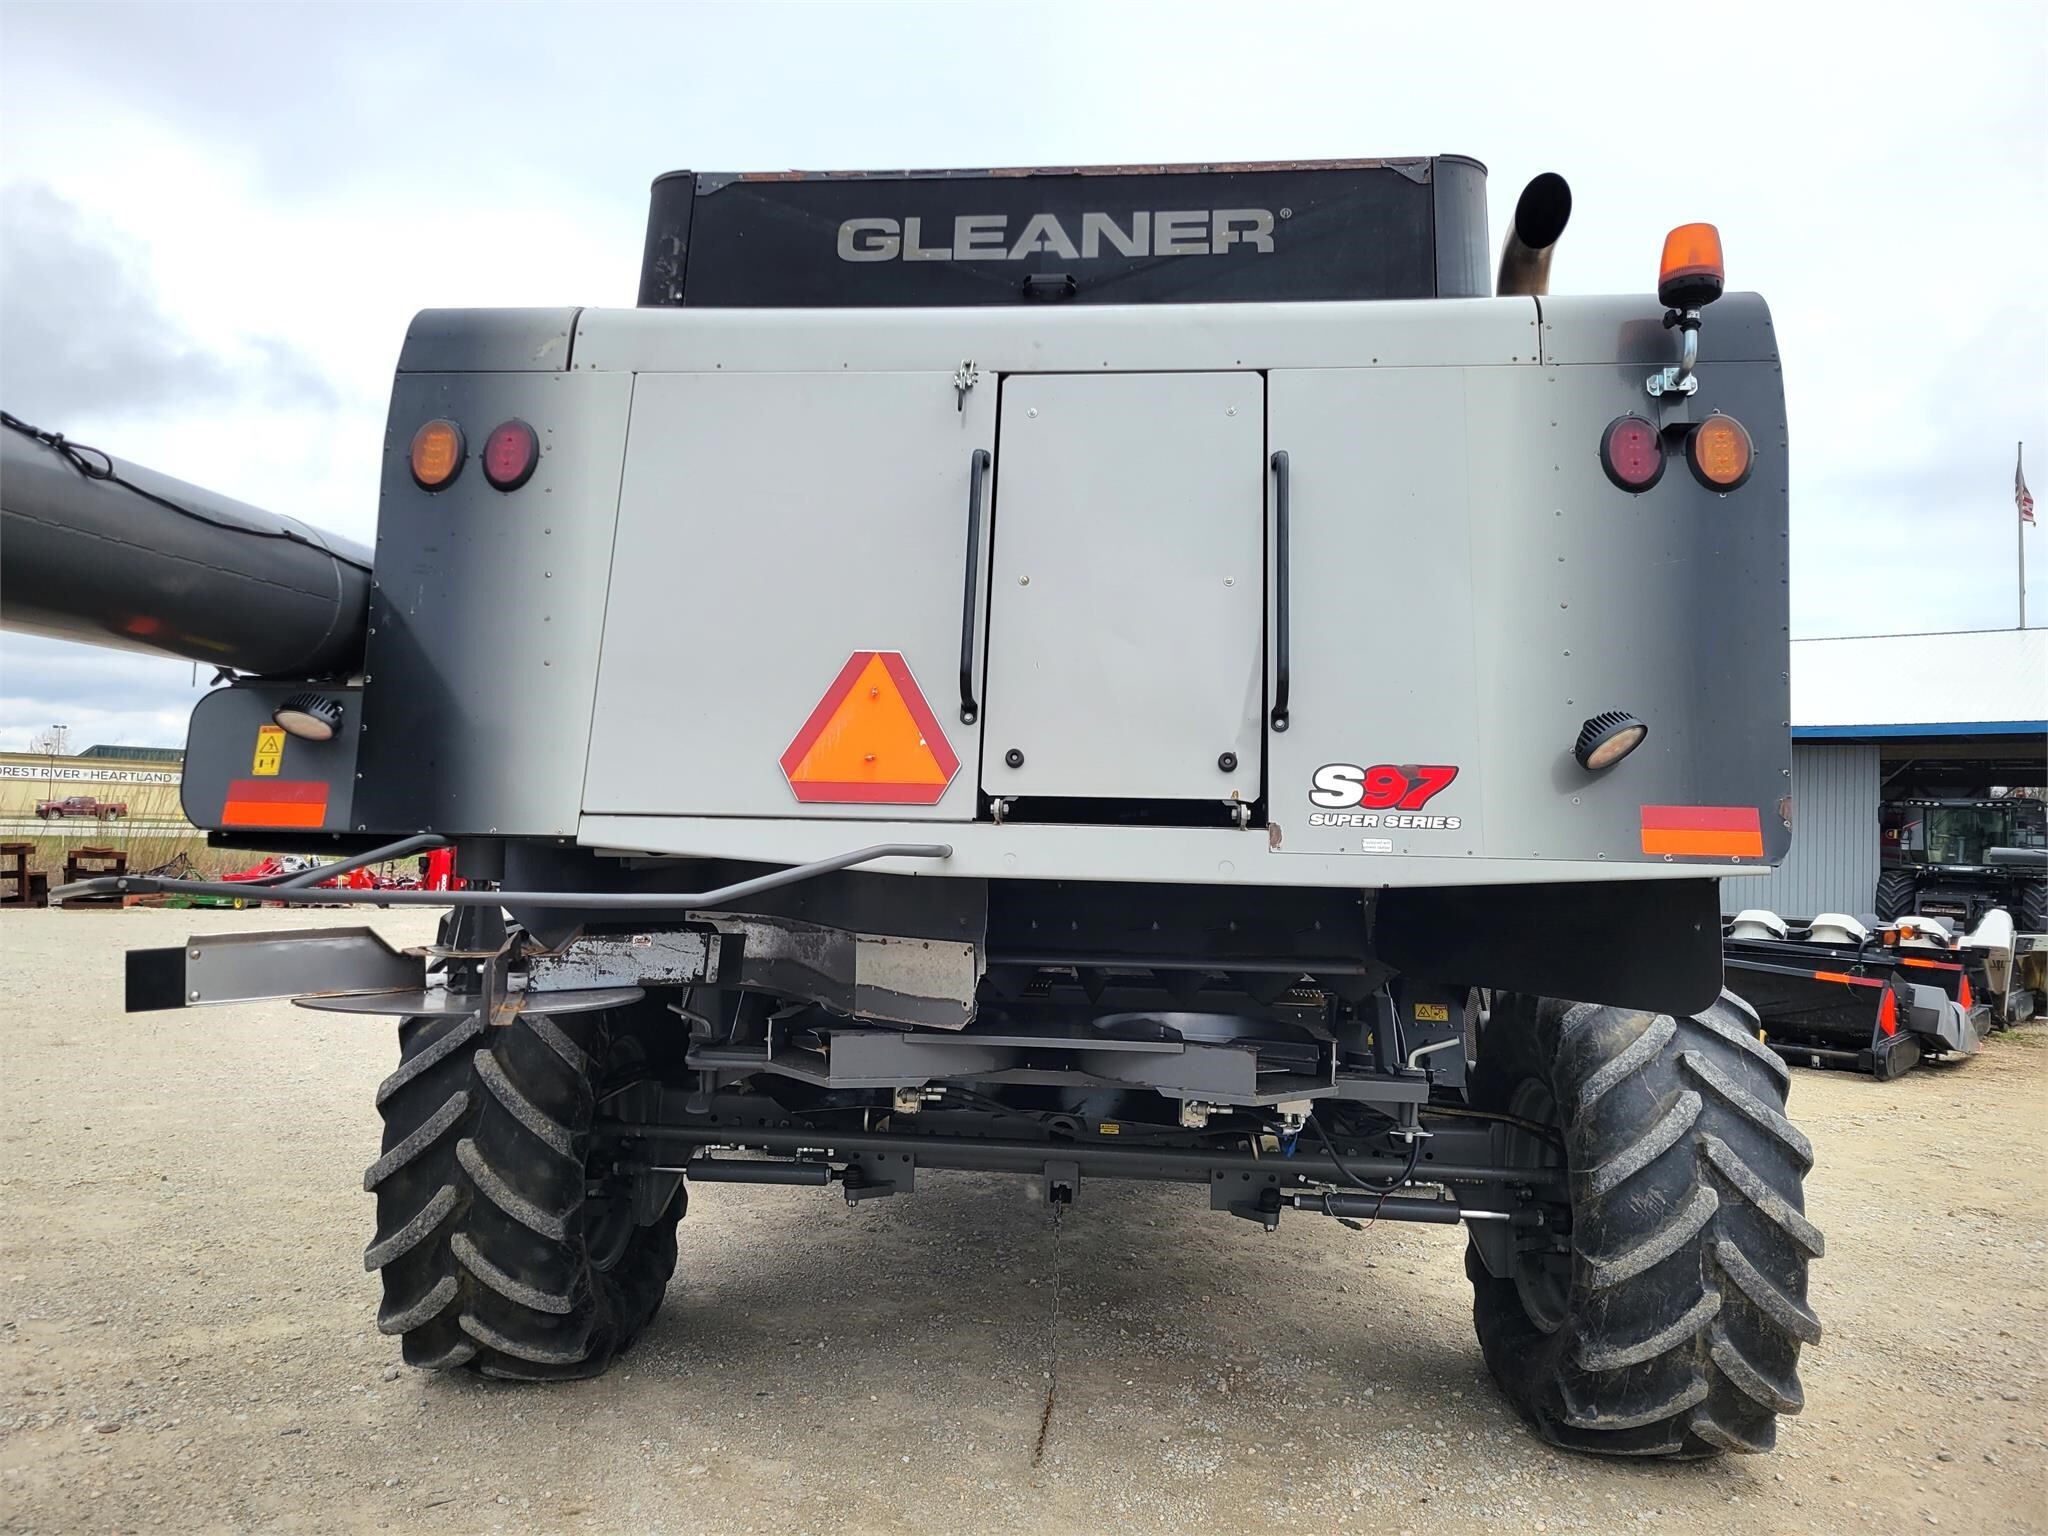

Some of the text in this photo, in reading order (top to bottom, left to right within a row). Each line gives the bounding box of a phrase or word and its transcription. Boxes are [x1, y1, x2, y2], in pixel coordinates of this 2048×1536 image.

[0, 766, 38, 777] REST
[90, 770, 172, 783] HEARTLAND
[1308, 763, 1459, 811] S97
[1309, 812, 1462, 829] SUPER SERIES
